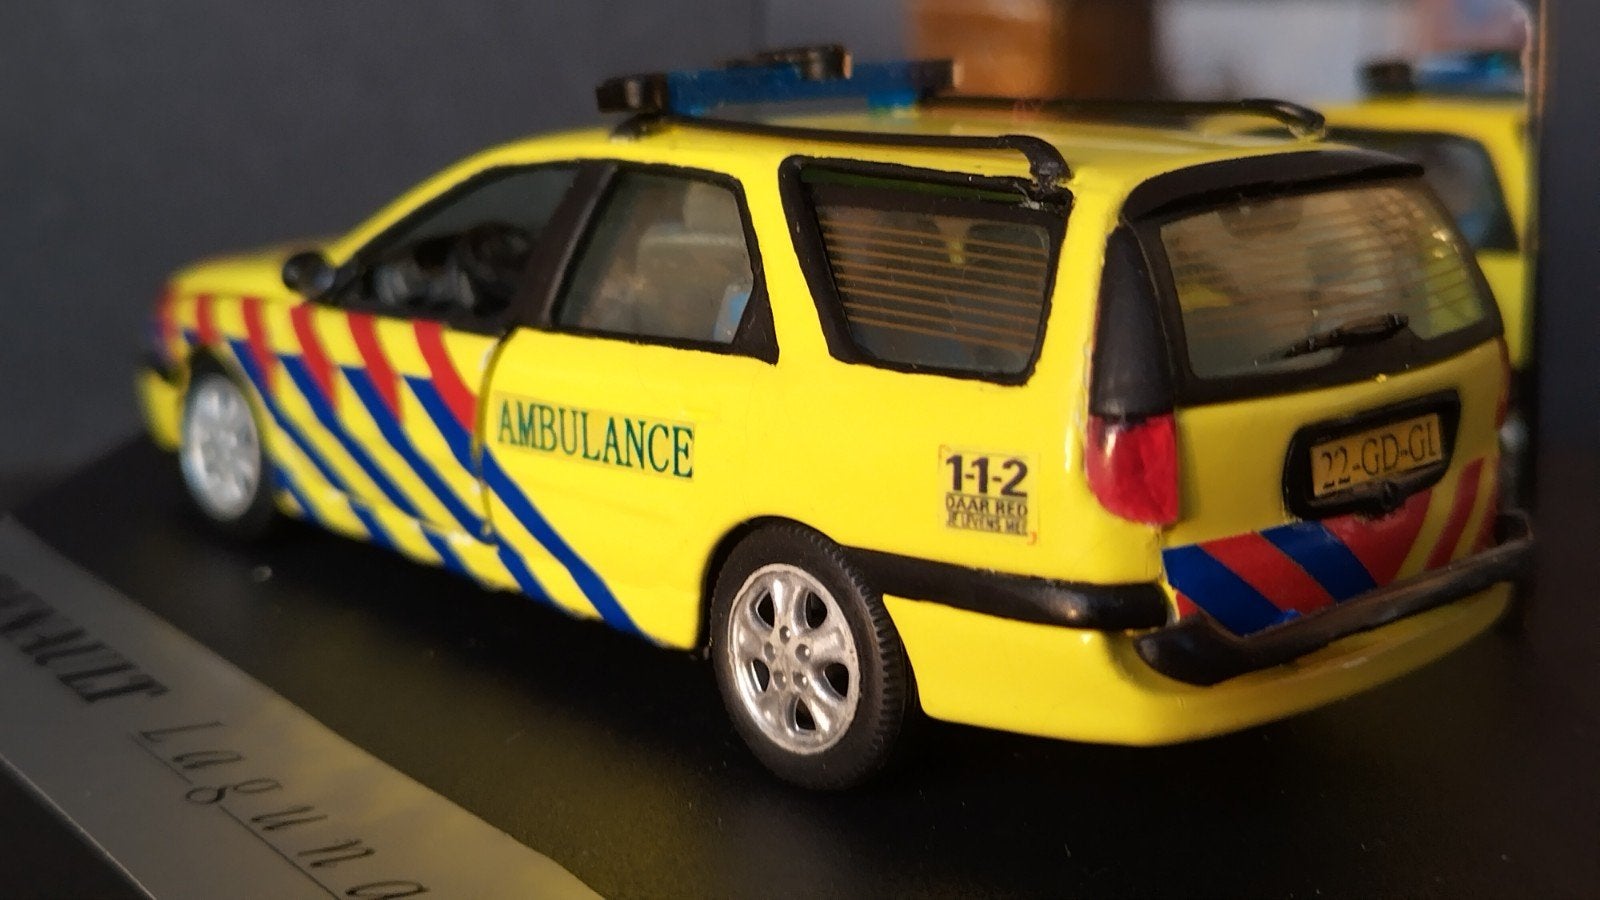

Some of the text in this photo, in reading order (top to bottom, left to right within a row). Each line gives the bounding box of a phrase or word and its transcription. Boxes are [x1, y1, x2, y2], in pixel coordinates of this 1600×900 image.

[497, 398, 695, 478] AMBULANCE
[1320, 421, 1437, 489] 22-GD-GL
[945, 454, 1028, 498] 1-1-2
[945, 494, 990, 514] DAAR
